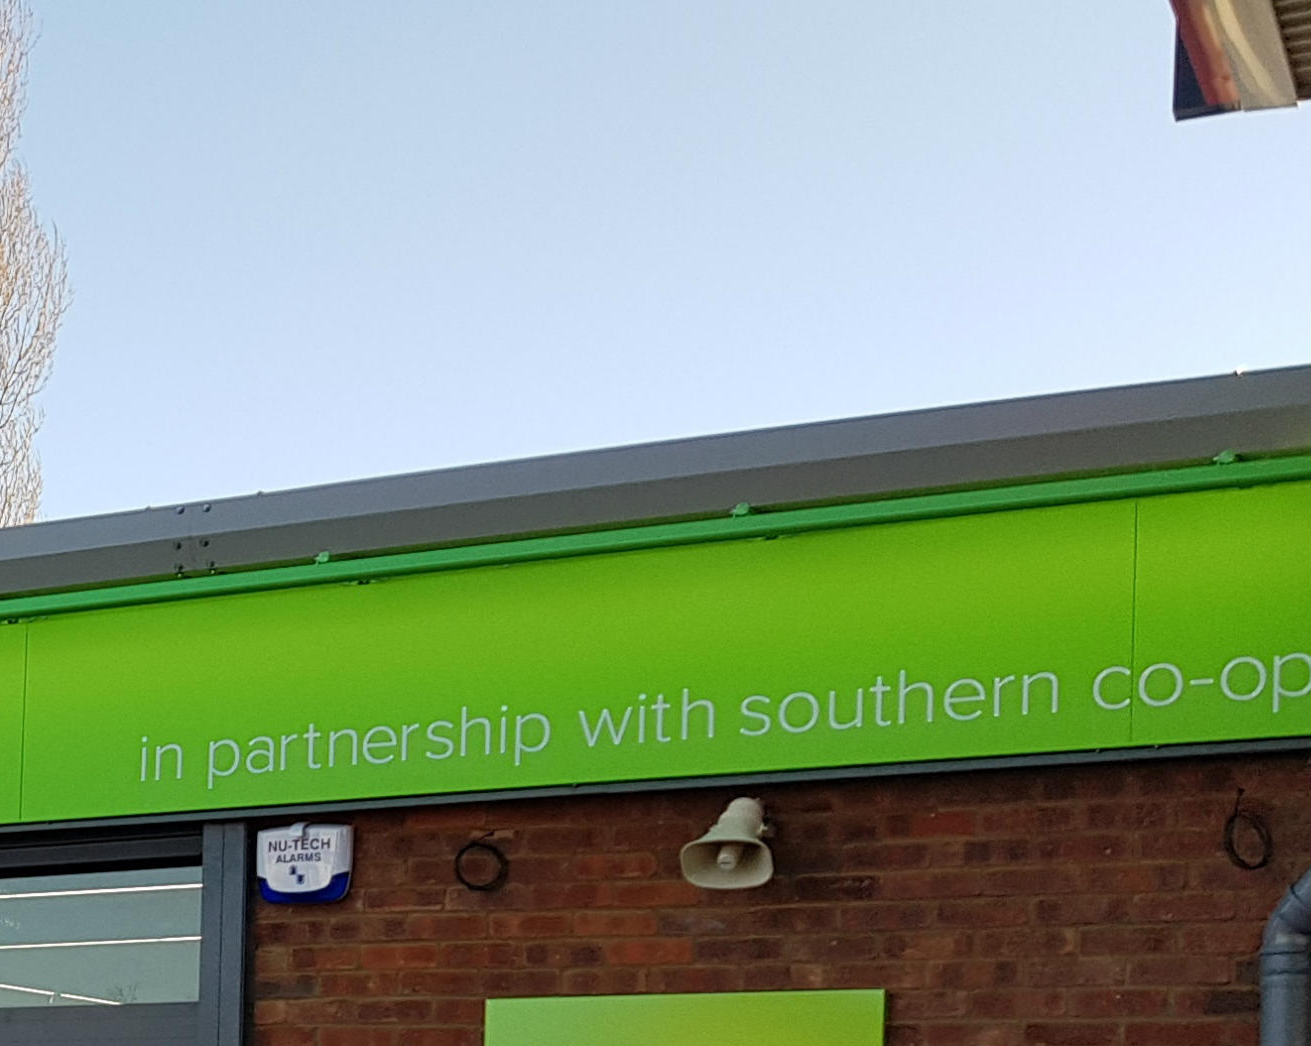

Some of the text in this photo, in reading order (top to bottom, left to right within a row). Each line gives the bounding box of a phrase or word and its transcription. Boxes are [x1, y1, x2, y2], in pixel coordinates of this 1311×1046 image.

[140, 652, 1311, 789] in partnership with southern co-op
[268, 838, 331, 852] NU-TECH
[276, 852, 322, 863] ALARMS
